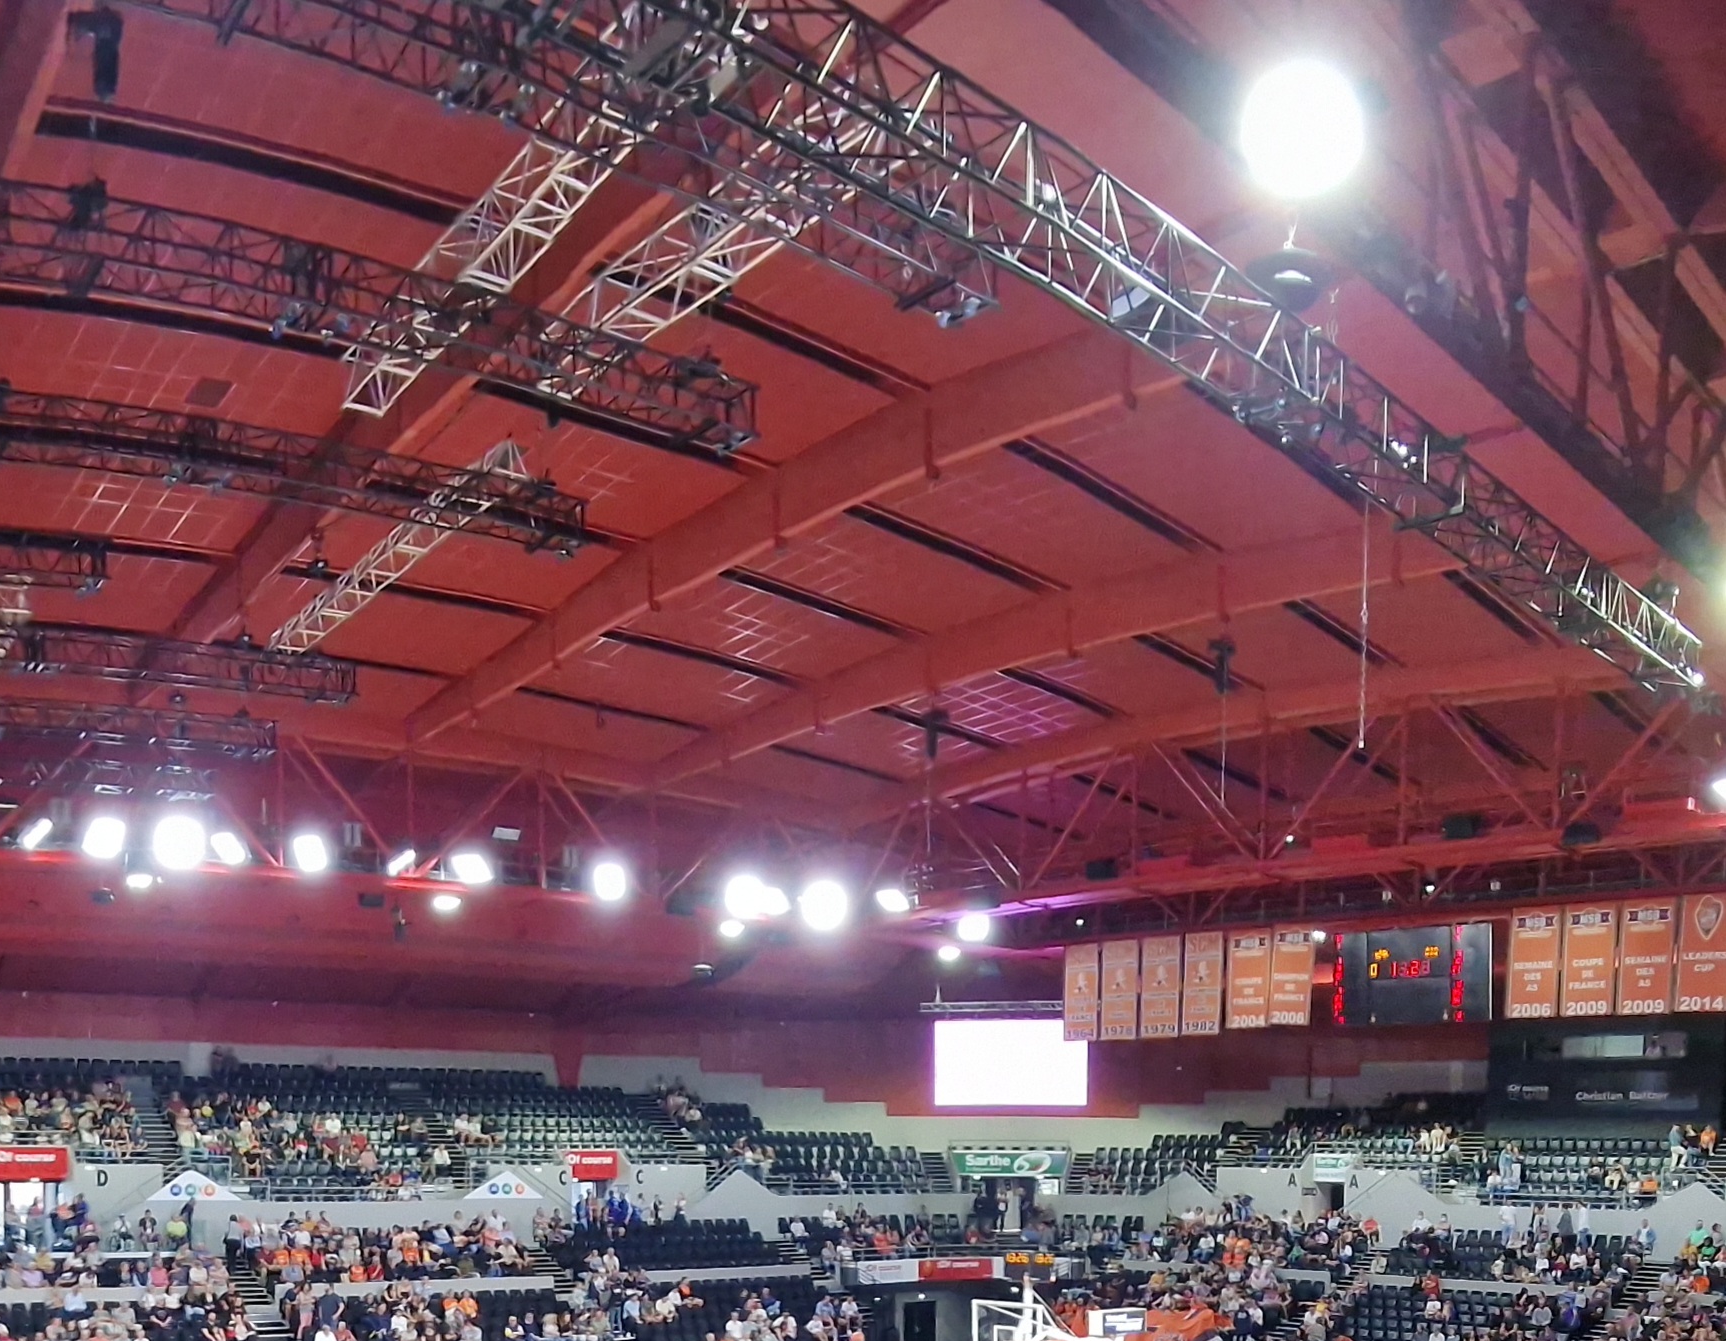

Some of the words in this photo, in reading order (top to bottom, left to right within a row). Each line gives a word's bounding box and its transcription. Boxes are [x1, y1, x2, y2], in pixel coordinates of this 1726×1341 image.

[1572, 957, 1605, 968] COUPE
[1694, 963, 1715, 973] CUP
[1568, 980, 1606, 991] FRANCE
[1232, 996, 1265, 1006] FRANCE
[1273, 993, 1305, 1002] FRANCE
[1680, 995, 1724, 1012] 2014
[1512, 1003, 1552, 1018] 2006
[1566, 1000, 1608, 1016] 2009
[1622, 999, 1665, 1015] 2009
[1185, 1020, 1216, 1032] 1982
[1231, 1014, 1266, 1028] 2004
[1143, 1023, 1176, 1035] 1979
[1575, 1090, 1624, 1101] Christian
[581, 1155, 613, 1165] course
[964, 1154, 1012, 1167] Sarthe
[96, 1169, 108, 1187] D
[558, 1169, 568, 1187] C
[635, 1168, 645, 1185] C
[1287, 1172, 1298, 1187] A
[1349, 1173, 1359, 1189] A
